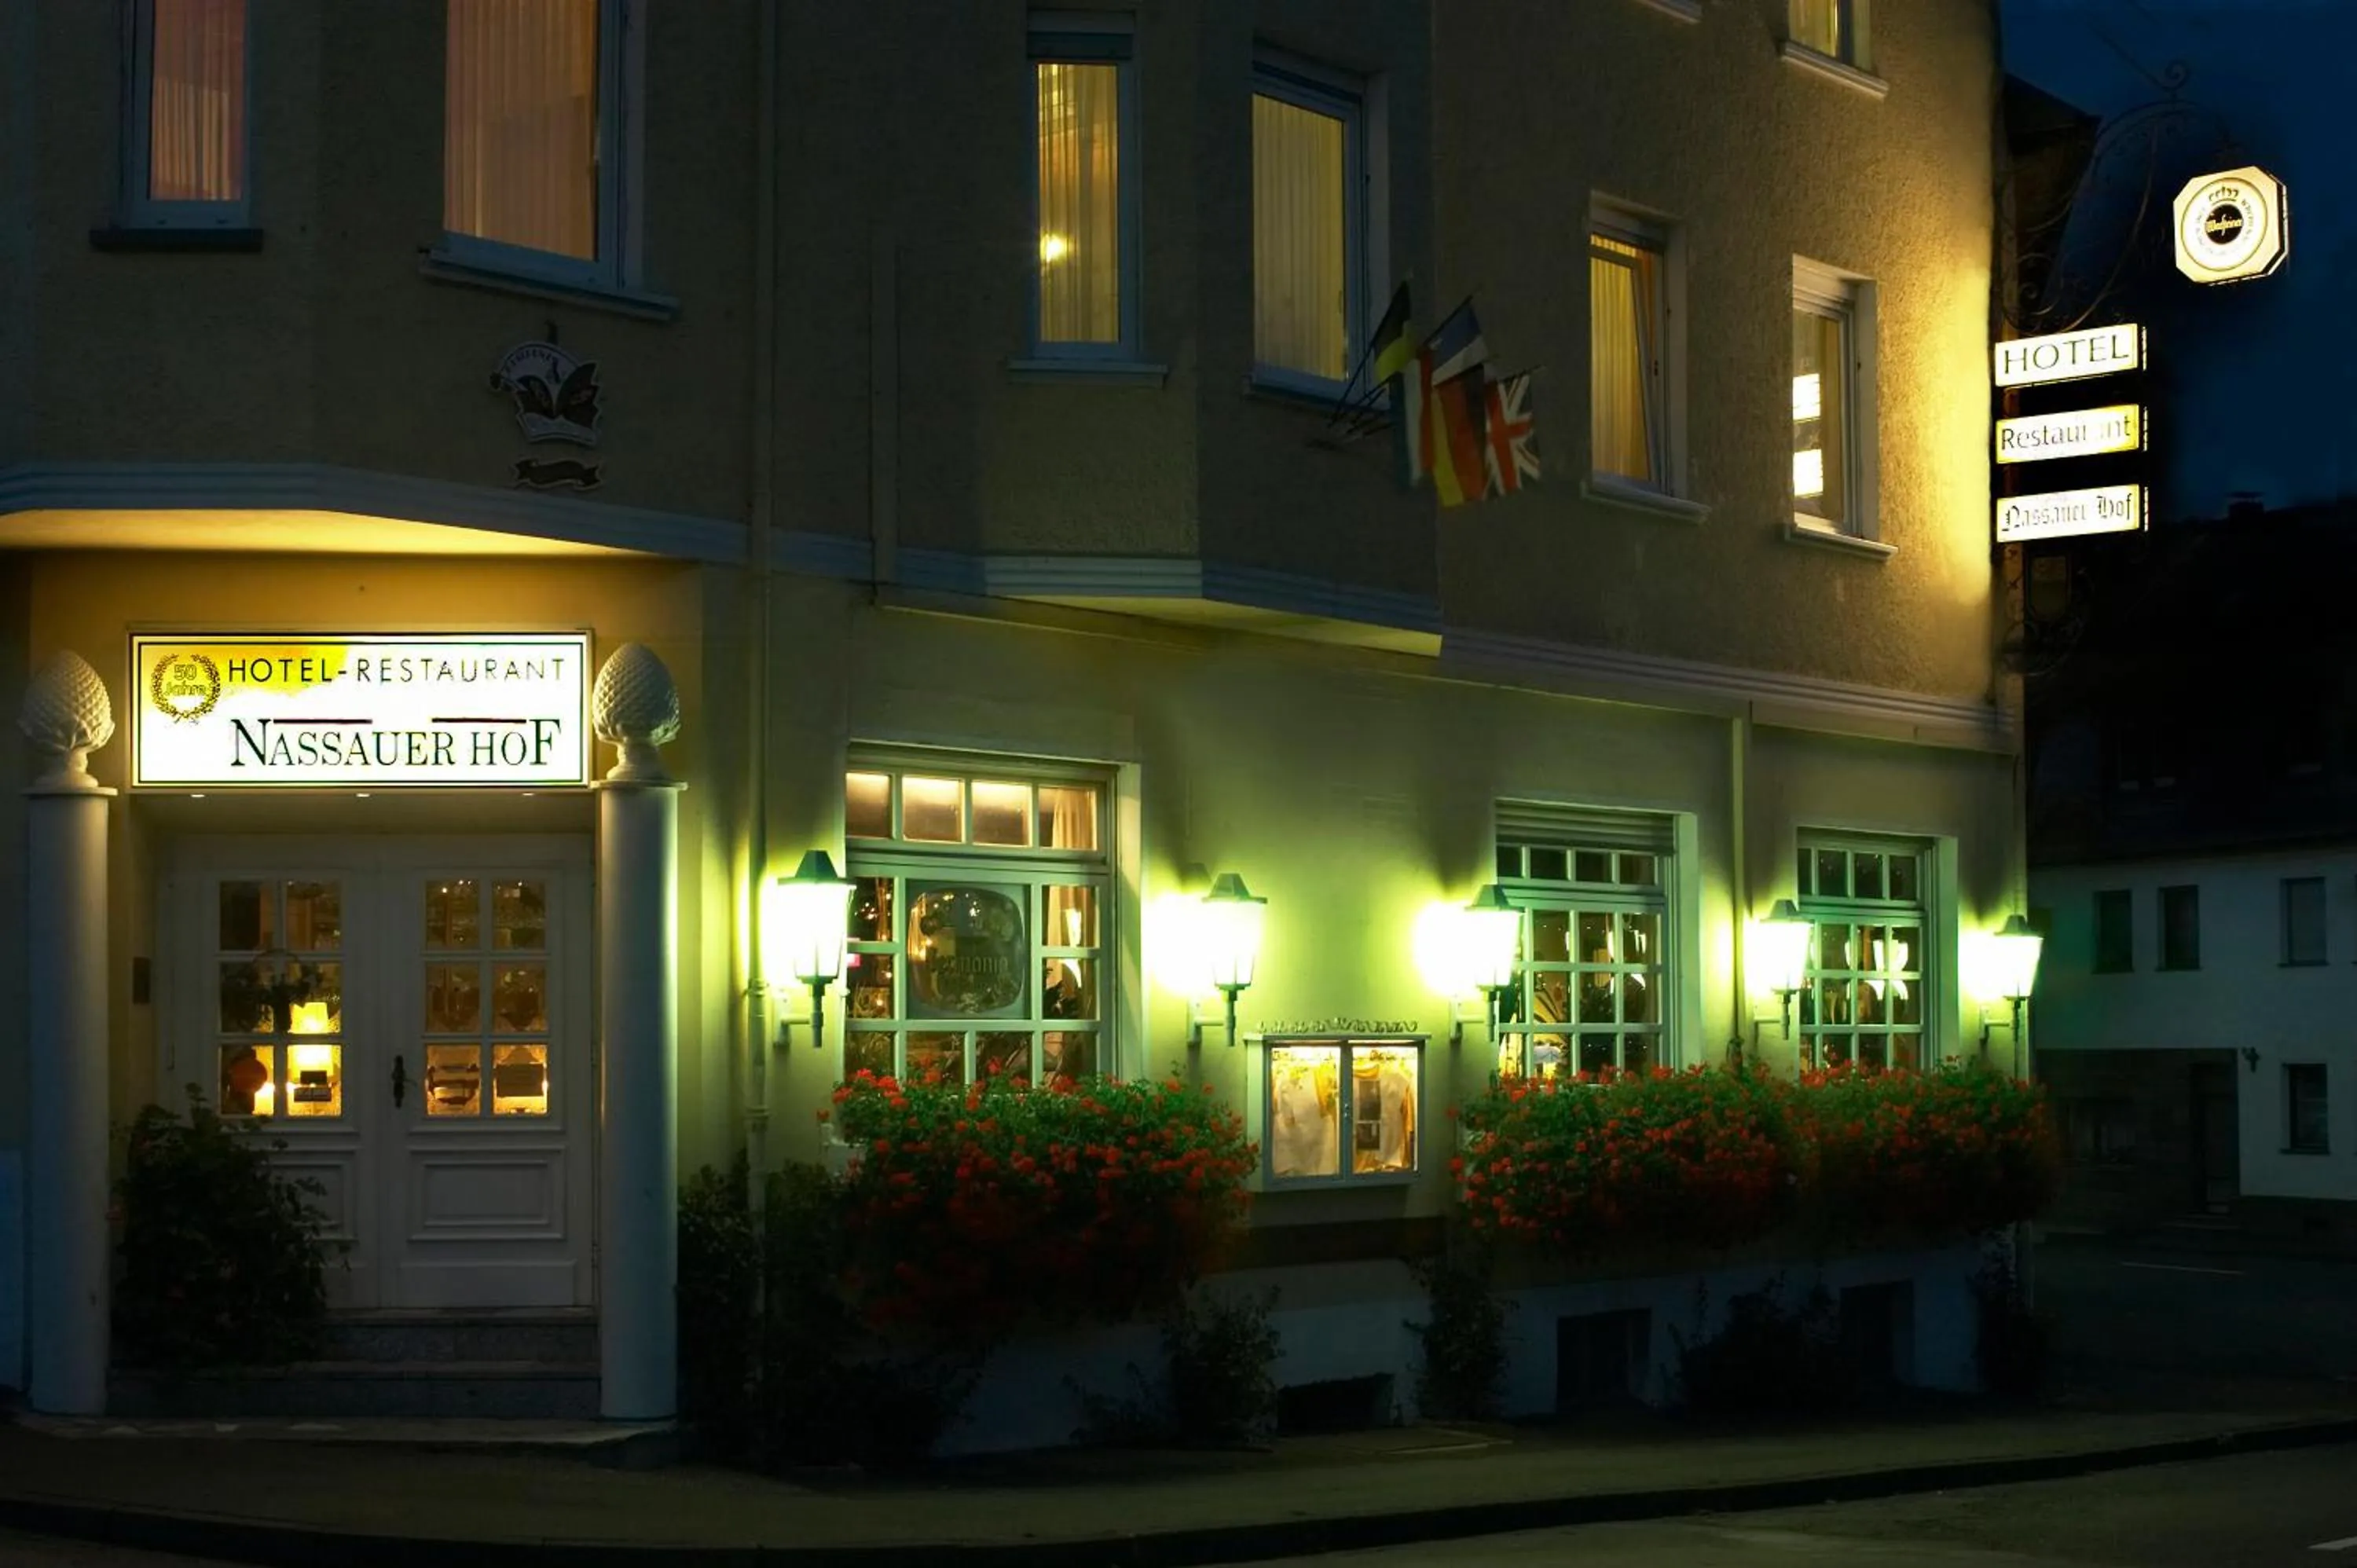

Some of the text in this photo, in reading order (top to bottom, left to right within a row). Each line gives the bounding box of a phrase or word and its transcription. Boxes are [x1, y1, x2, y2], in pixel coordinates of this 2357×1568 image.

[2003, 334, 2130, 375] HOTEL
[2001, 415, 2131, 451] Restaurnt
[2095, 493, 2133, 522] Hof
[172, 664, 197, 681] 50
[228, 658, 565, 683] HOTEL-RESTAURANT
[163, 680, 207, 696] Jahre
[229, 717, 563, 768] NASSAUER HOF
